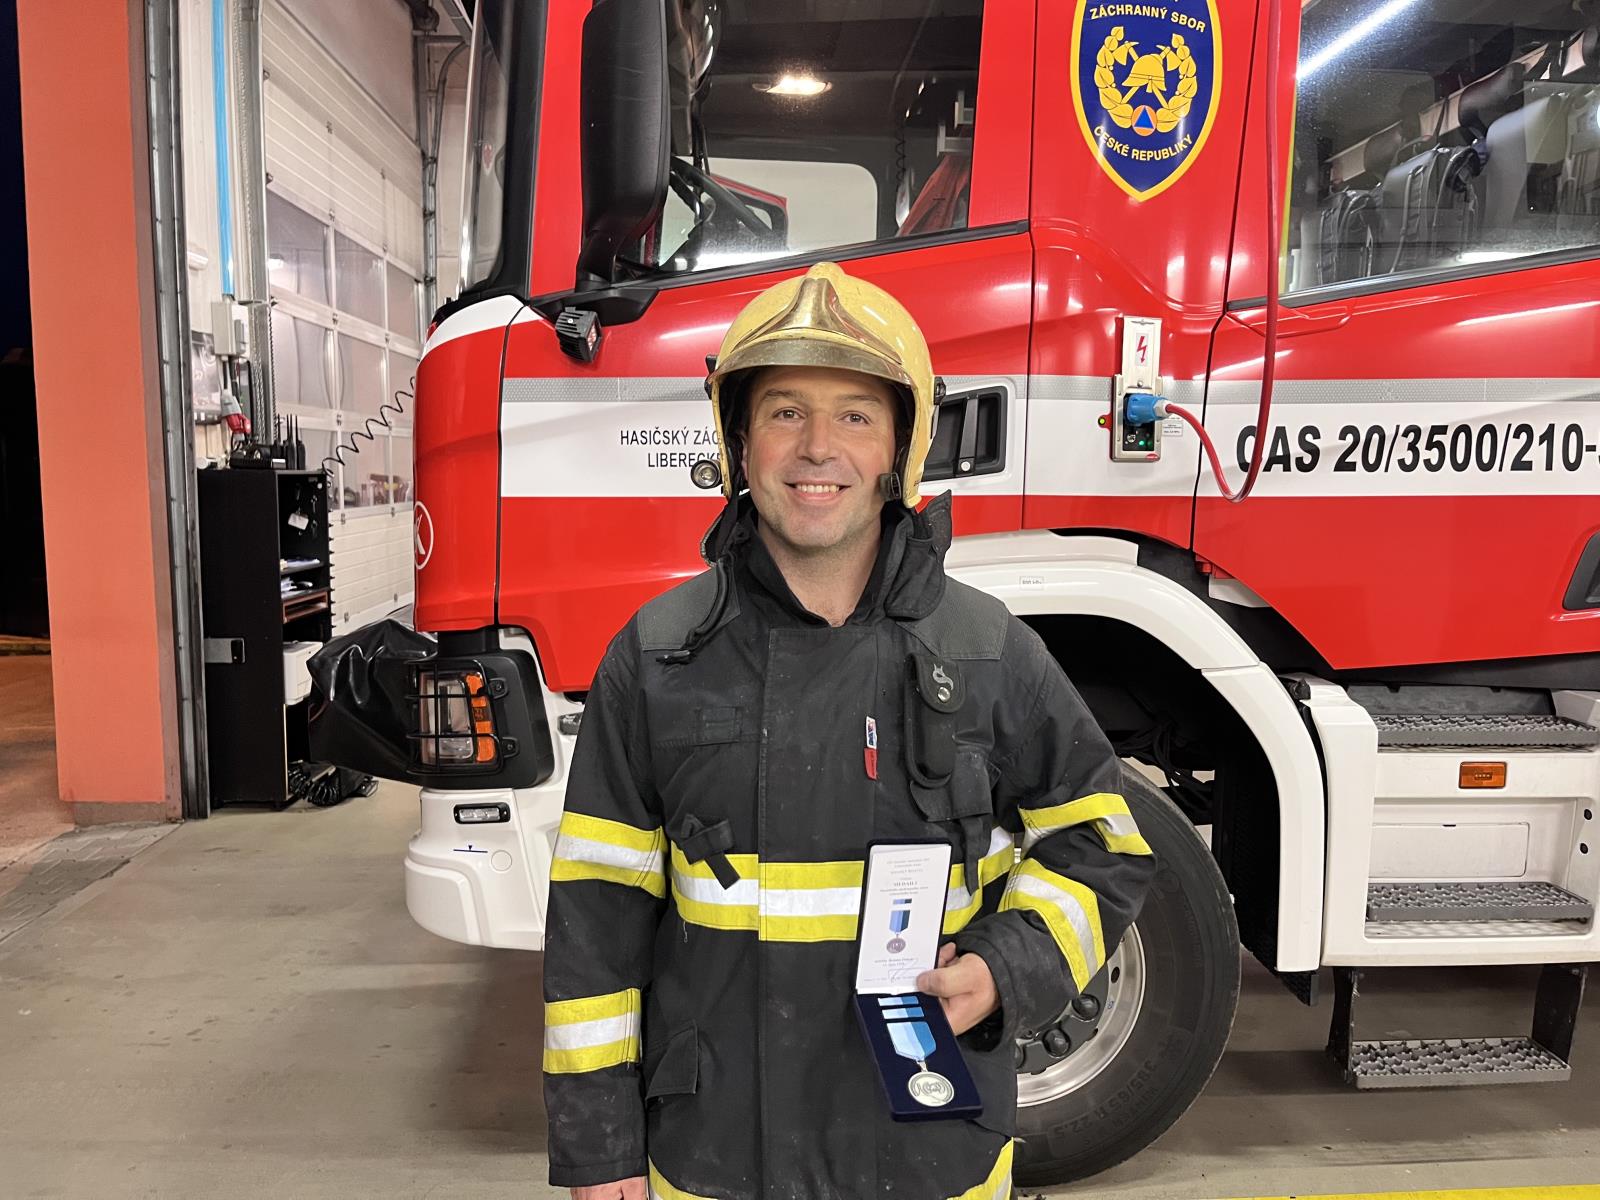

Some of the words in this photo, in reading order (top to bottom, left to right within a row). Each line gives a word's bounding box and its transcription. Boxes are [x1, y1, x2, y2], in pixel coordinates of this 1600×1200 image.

[1089, 4, 1168, 20] ZÁCHRANNÝ
[1170, 11, 1206, 33] SBOR
[1131, 133, 1193, 161] REPUBLIKY
[620, 426, 689, 445] HASIČSKÝ
[1236, 425, 1321, 473] CAS
[1333, 423, 1600, 473] 20/3500/210-
